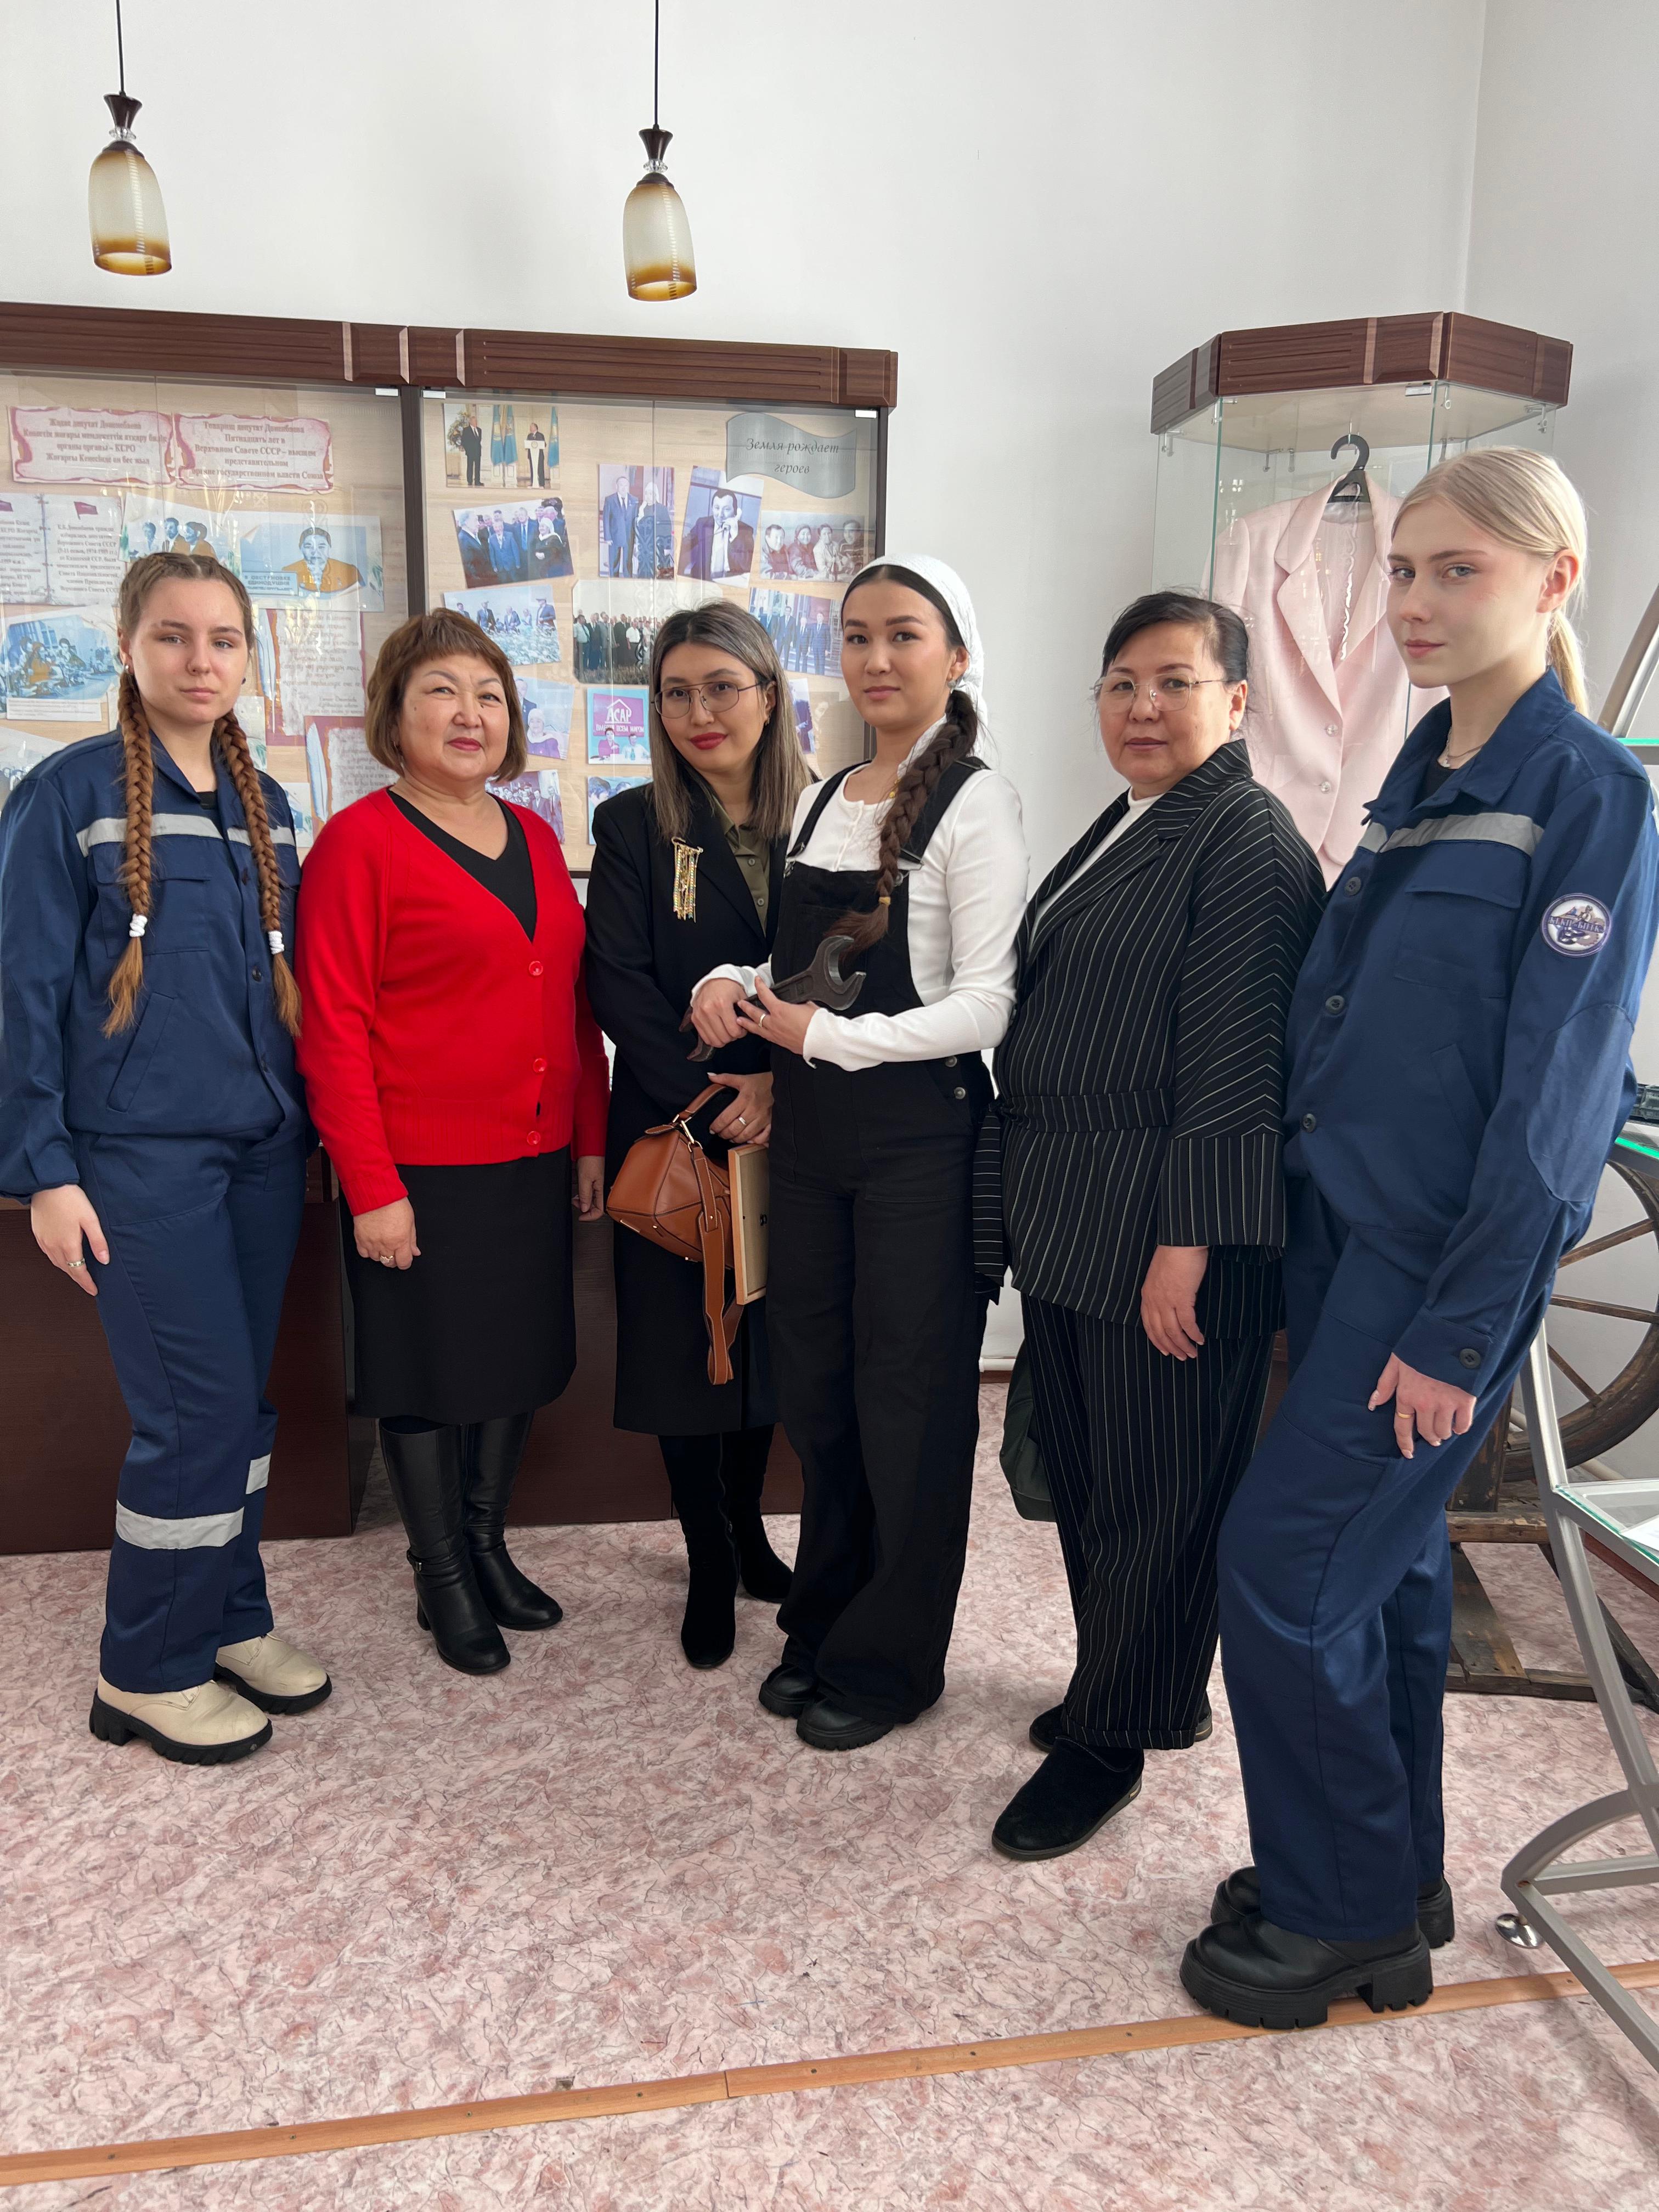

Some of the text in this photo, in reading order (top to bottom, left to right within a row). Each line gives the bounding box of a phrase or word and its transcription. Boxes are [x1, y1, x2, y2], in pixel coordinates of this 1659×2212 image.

[204, 421, 235, 431] Товарищ
[236, 424, 263, 432] депутат
[225, 433, 266, 443] Пятнадцать
[115, 443, 136, 453] КСРО
[194, 444, 233, 454] Верховном
[234, 446, 258, 455] Совете
[260, 447, 281, 455] СССР
[746, 438, 839, 455] Земля рождает
[224, 458, 289, 467] представительном
[774, 464, 810, 475] героев
